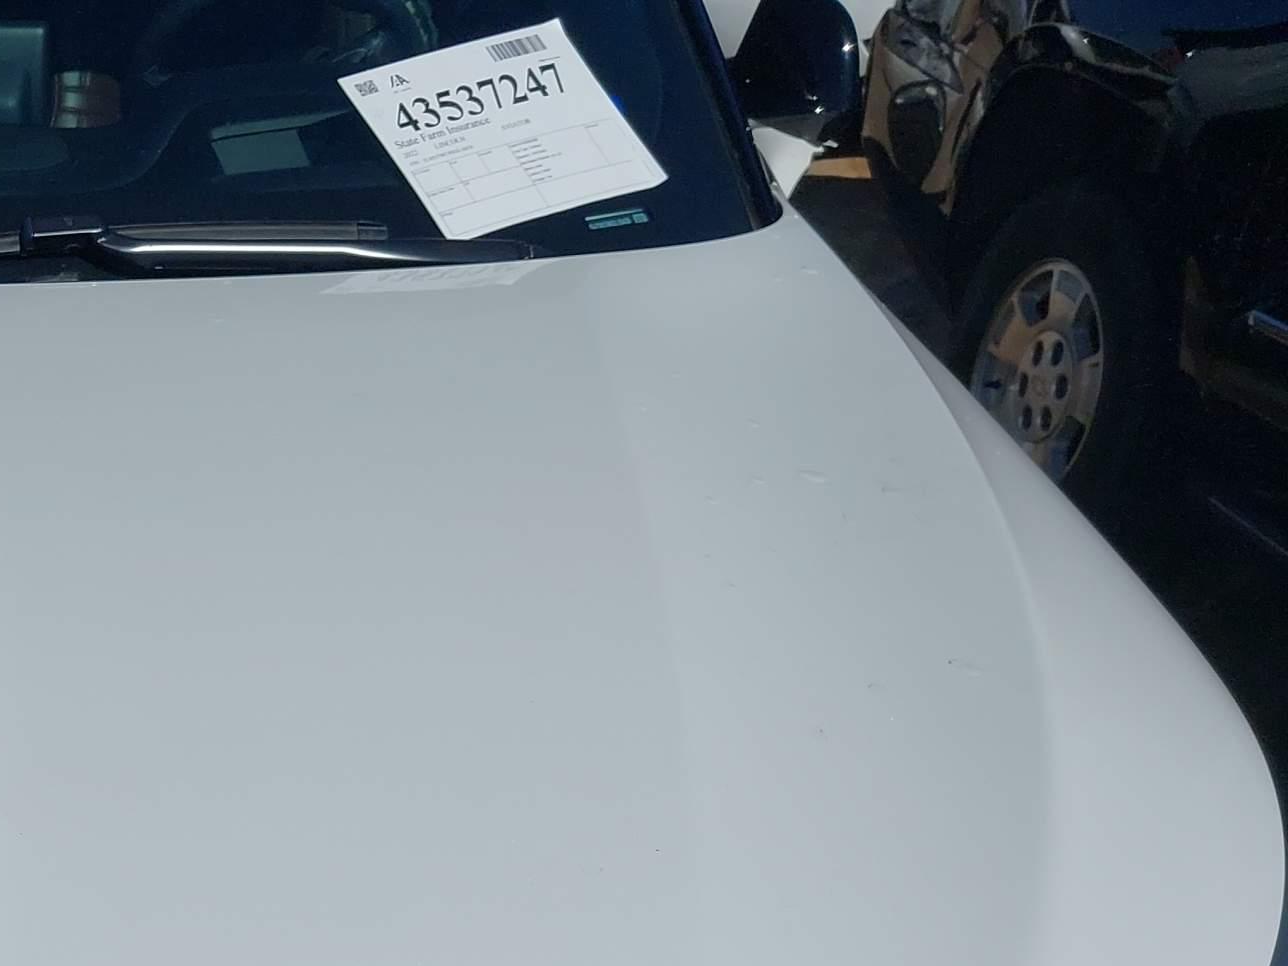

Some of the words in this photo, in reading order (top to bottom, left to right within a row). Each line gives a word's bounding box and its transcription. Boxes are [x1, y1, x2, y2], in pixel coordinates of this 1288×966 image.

[397, 62, 564, 131] 43537247
[394, 137, 420, 149] State
[420, 130, 447, 142] Farm
[446, 118, 491, 135] Insurance
